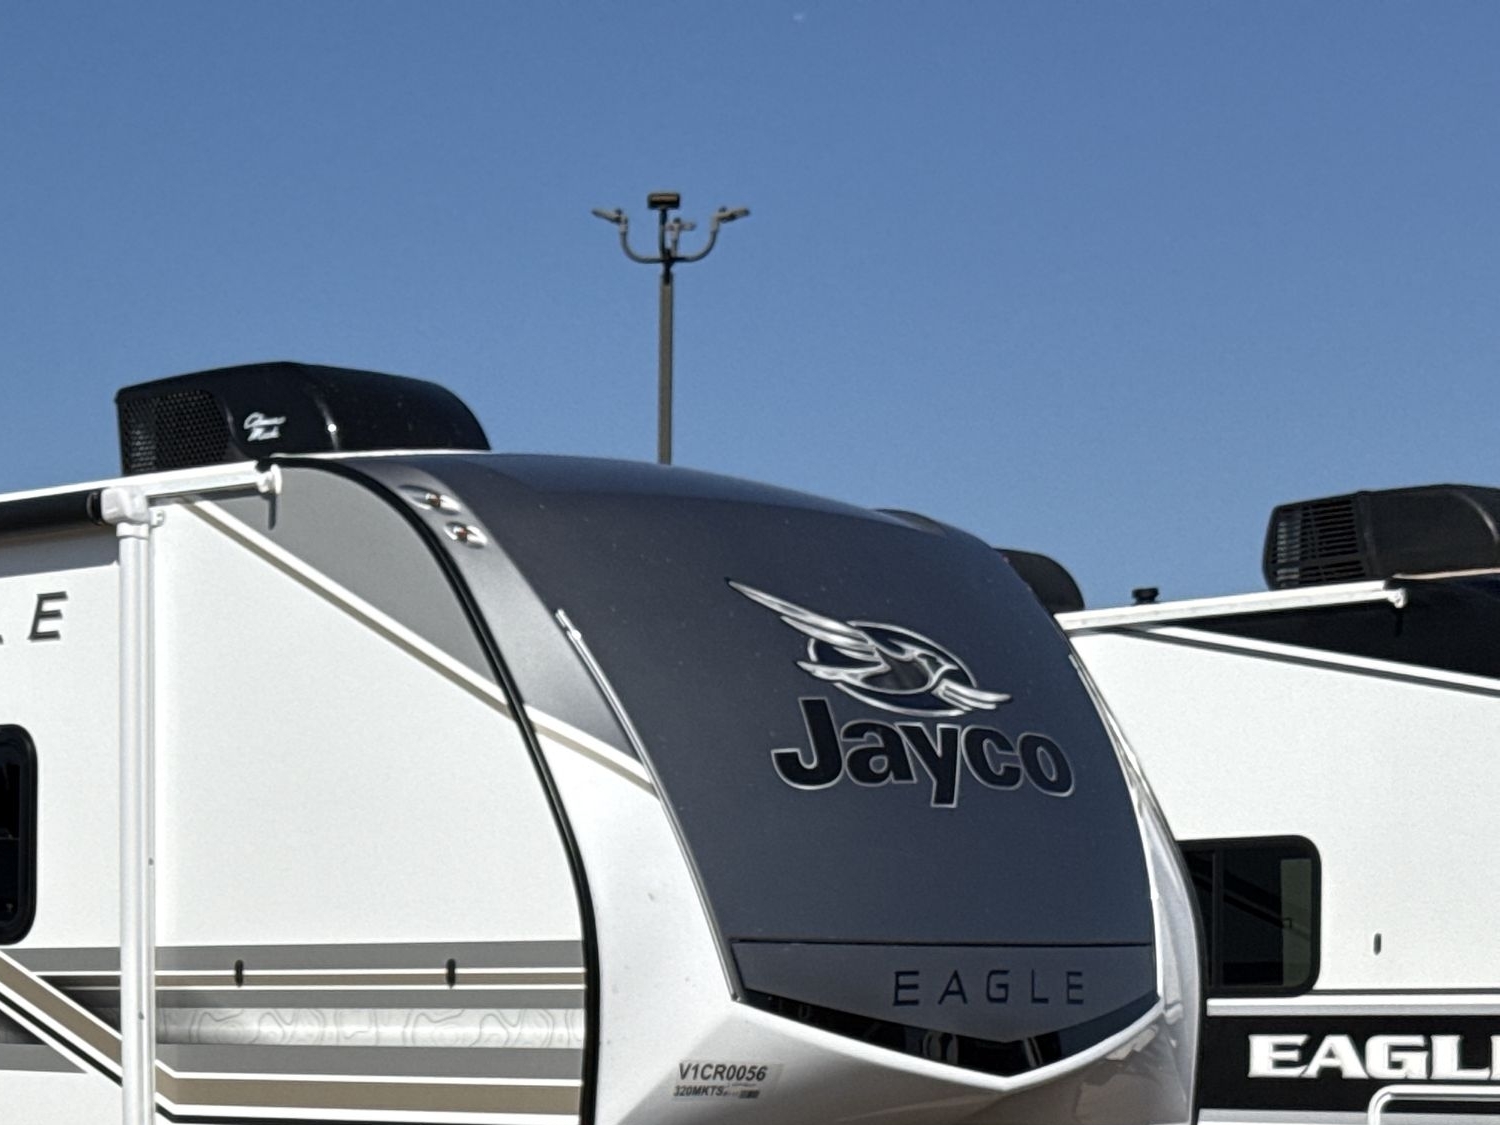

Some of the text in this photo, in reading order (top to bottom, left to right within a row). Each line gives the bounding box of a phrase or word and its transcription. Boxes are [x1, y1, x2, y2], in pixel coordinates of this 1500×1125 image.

[771, 698, 1075, 808] Jayco
[892, 969, 1085, 1007] EAGLE
[679, 1063, 768, 1081] V1CR0056
[1248, 1034, 1500, 1080] EAGL
